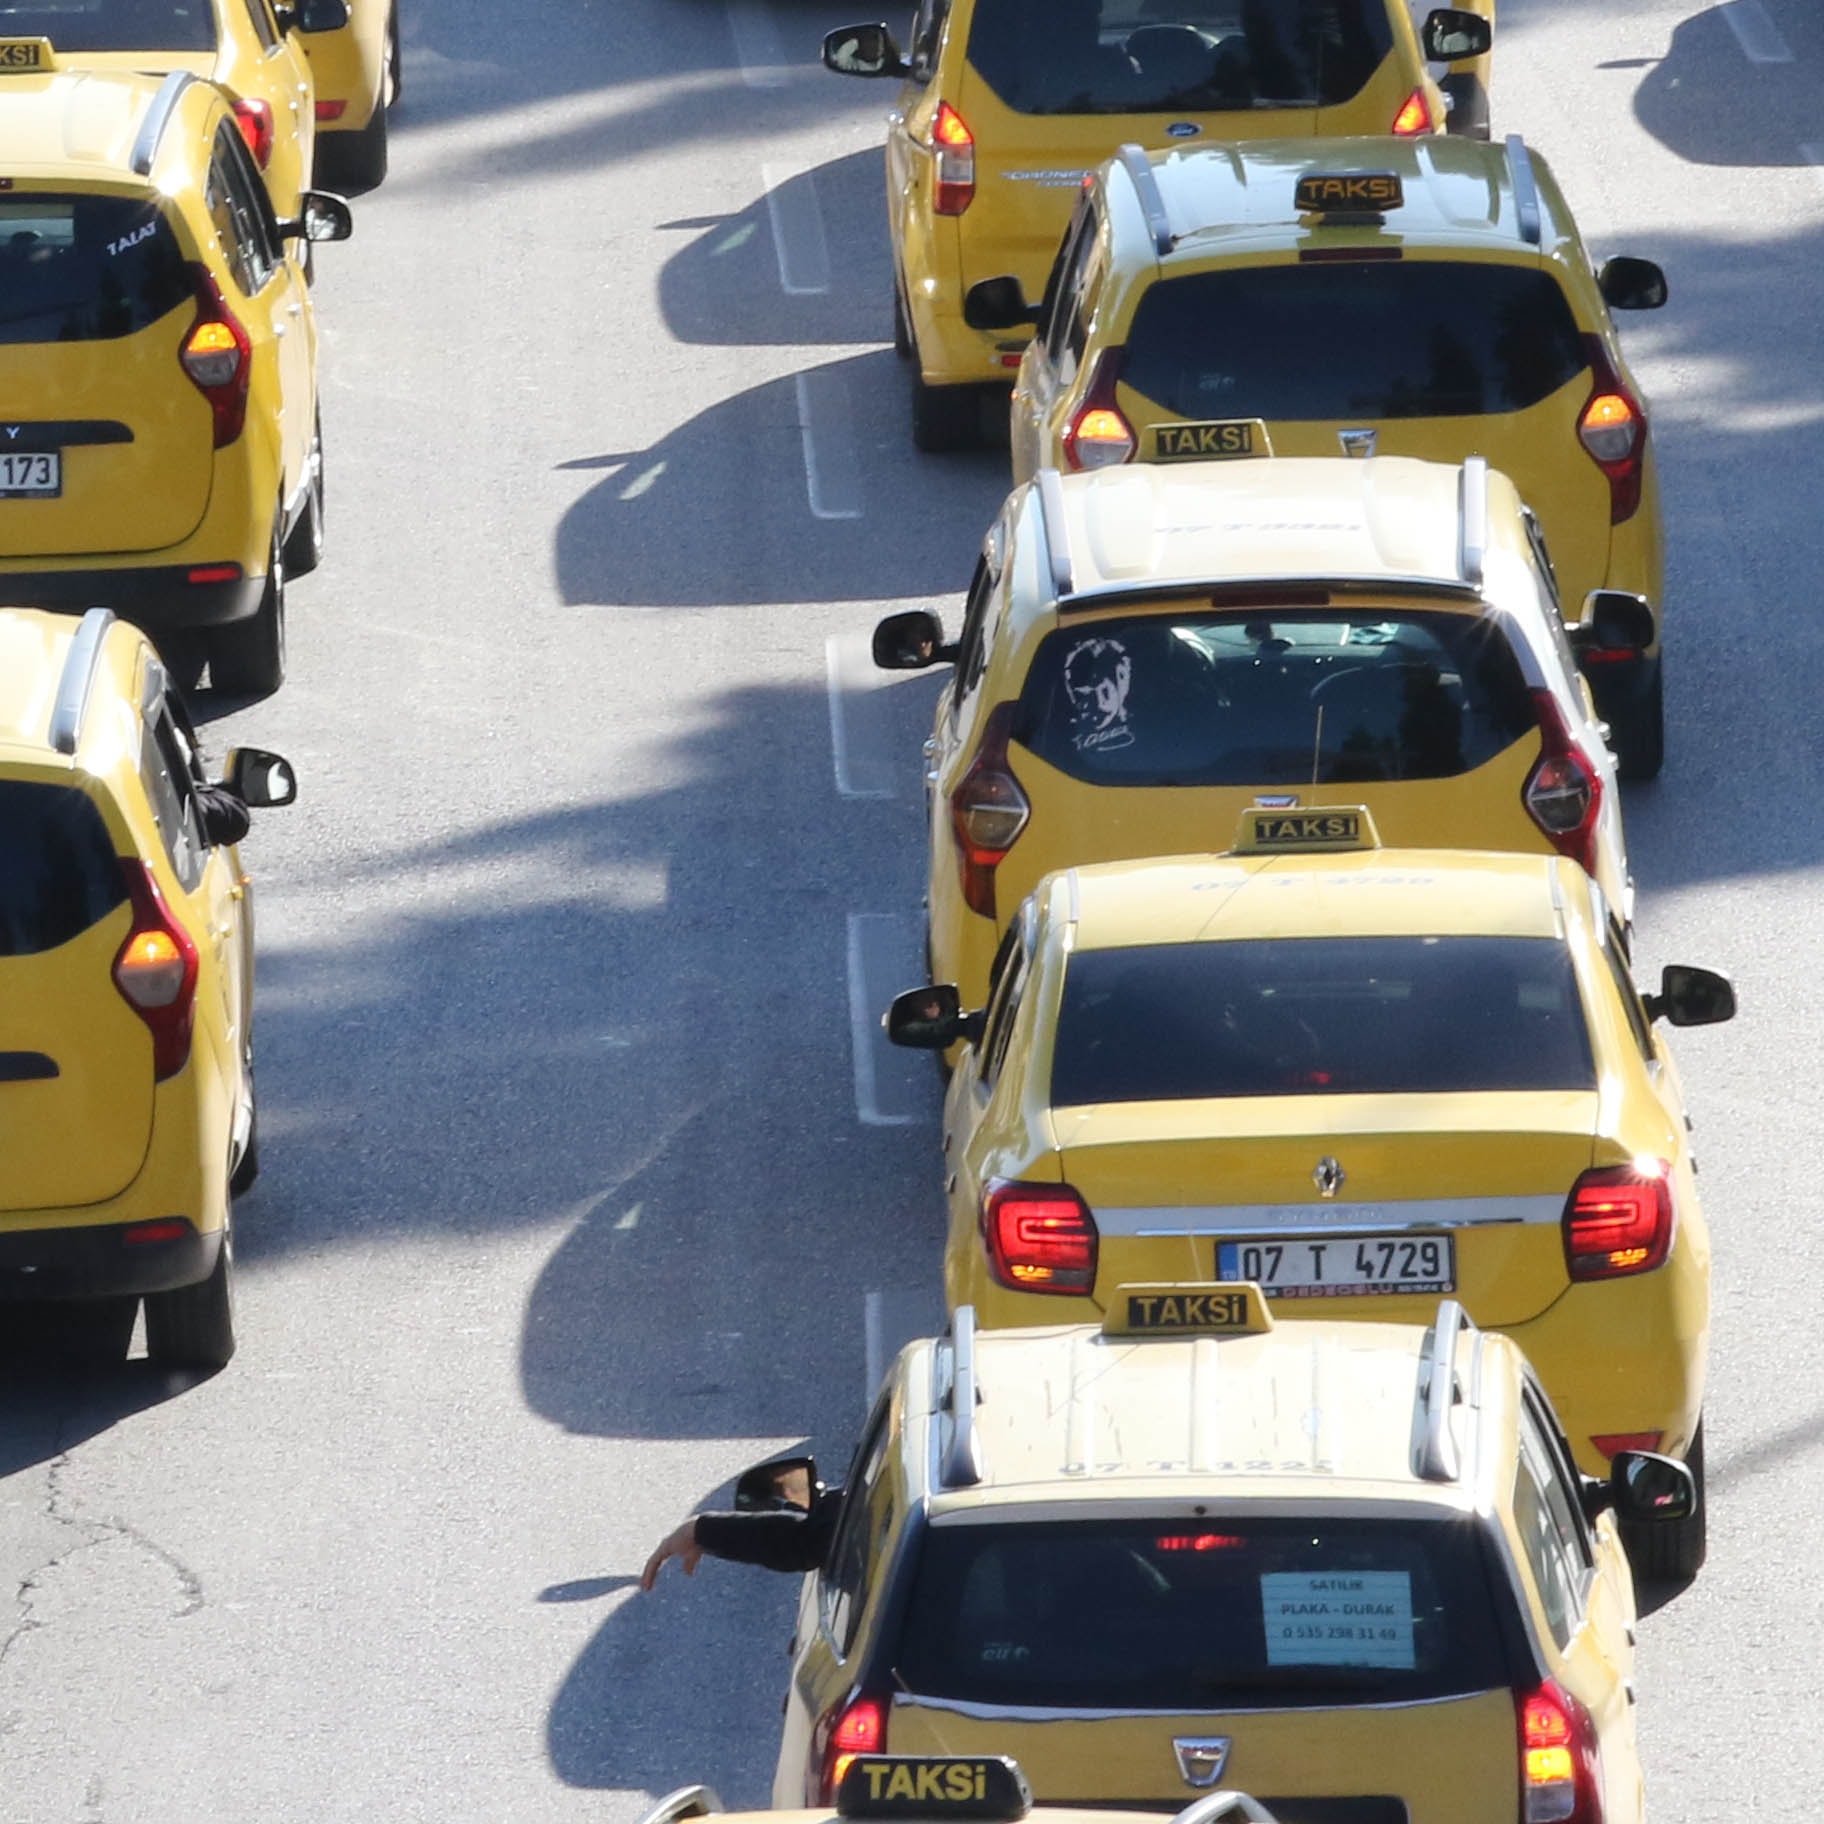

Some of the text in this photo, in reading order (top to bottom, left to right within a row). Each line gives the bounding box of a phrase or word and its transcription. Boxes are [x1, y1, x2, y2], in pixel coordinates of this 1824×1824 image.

[106, 221, 156, 256] TALAT
[1243, 1241, 1440, 1281] 07 T 4729
[1309, 1579, 1364, 1592] SATILIK
[1280, 1602, 1331, 1616] PLAKA
[1343, 1603, 1394, 1616] DURAK
[1282, 1627, 1291, 1640] 0
[1297, 1627, 1323, 1640] 535
[1357, 1628, 1375, 1640] 31
